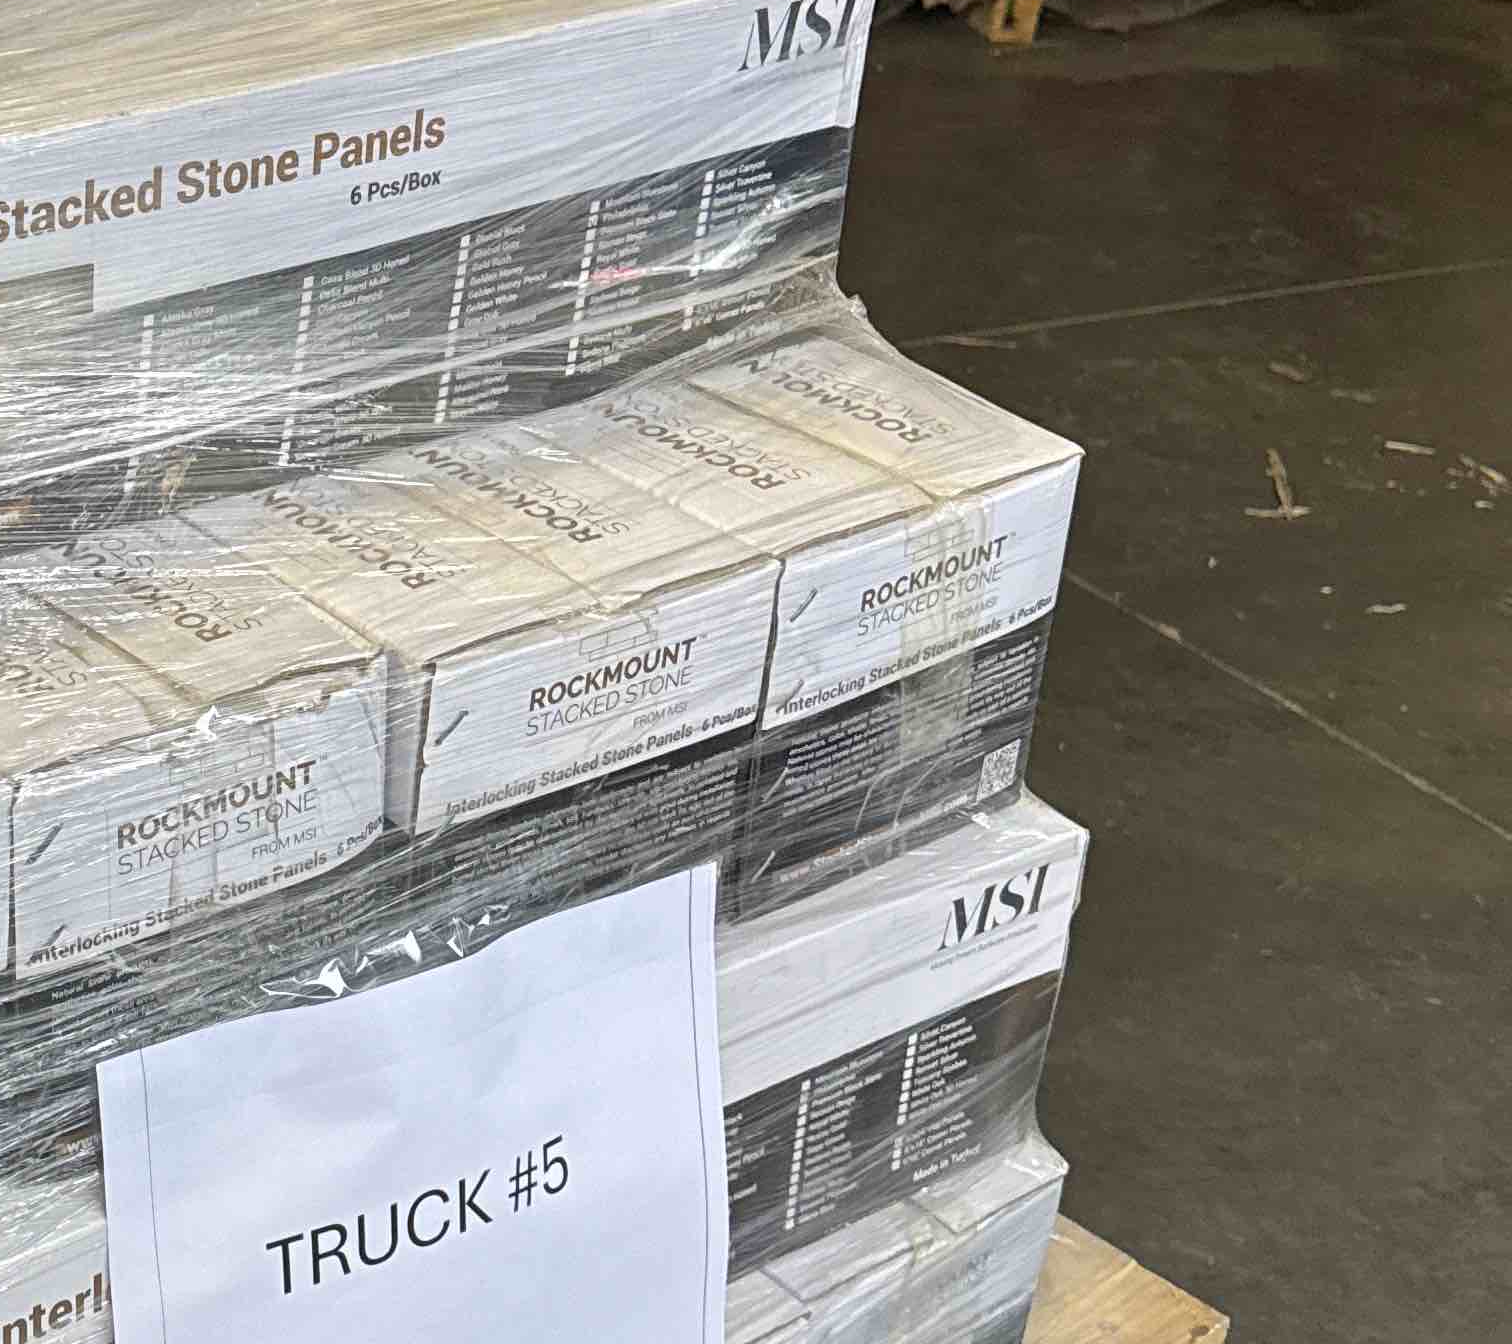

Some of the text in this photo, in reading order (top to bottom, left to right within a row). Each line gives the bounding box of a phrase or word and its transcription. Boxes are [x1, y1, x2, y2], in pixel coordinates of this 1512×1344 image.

[177, 149, 299, 205] Stone
[313, 109, 446, 176] Panels
[350, 168, 443, 206] 6 Pcs/Box
[856, 563, 1002, 637] STACKED STONE
[859, 534, 1009, 614] ROCKMOUNT
[525, 664, 693, 738] STACKED STONE
[527, 635, 700, 713] ROCKMOUNT
[869, 648, 922, 682] Stacked
[539, 753, 600, 786] Stacked
[601, 739, 645, 767] Stone
[645, 722, 693, 753] Panels
[116, 760, 318, 850] ROCKMOUNT
[117, 787, 319, 875] STACKED STONE
[250, 826, 319, 860] FROM MSI
[144, 886, 216, 930] Stacked
[218, 869, 270, 904] Stone
[271, 849, 328, 887] Panels
[937, 862, 1050, 952] MSI
[266, 1136, 571, 1295] TRUCK #5
